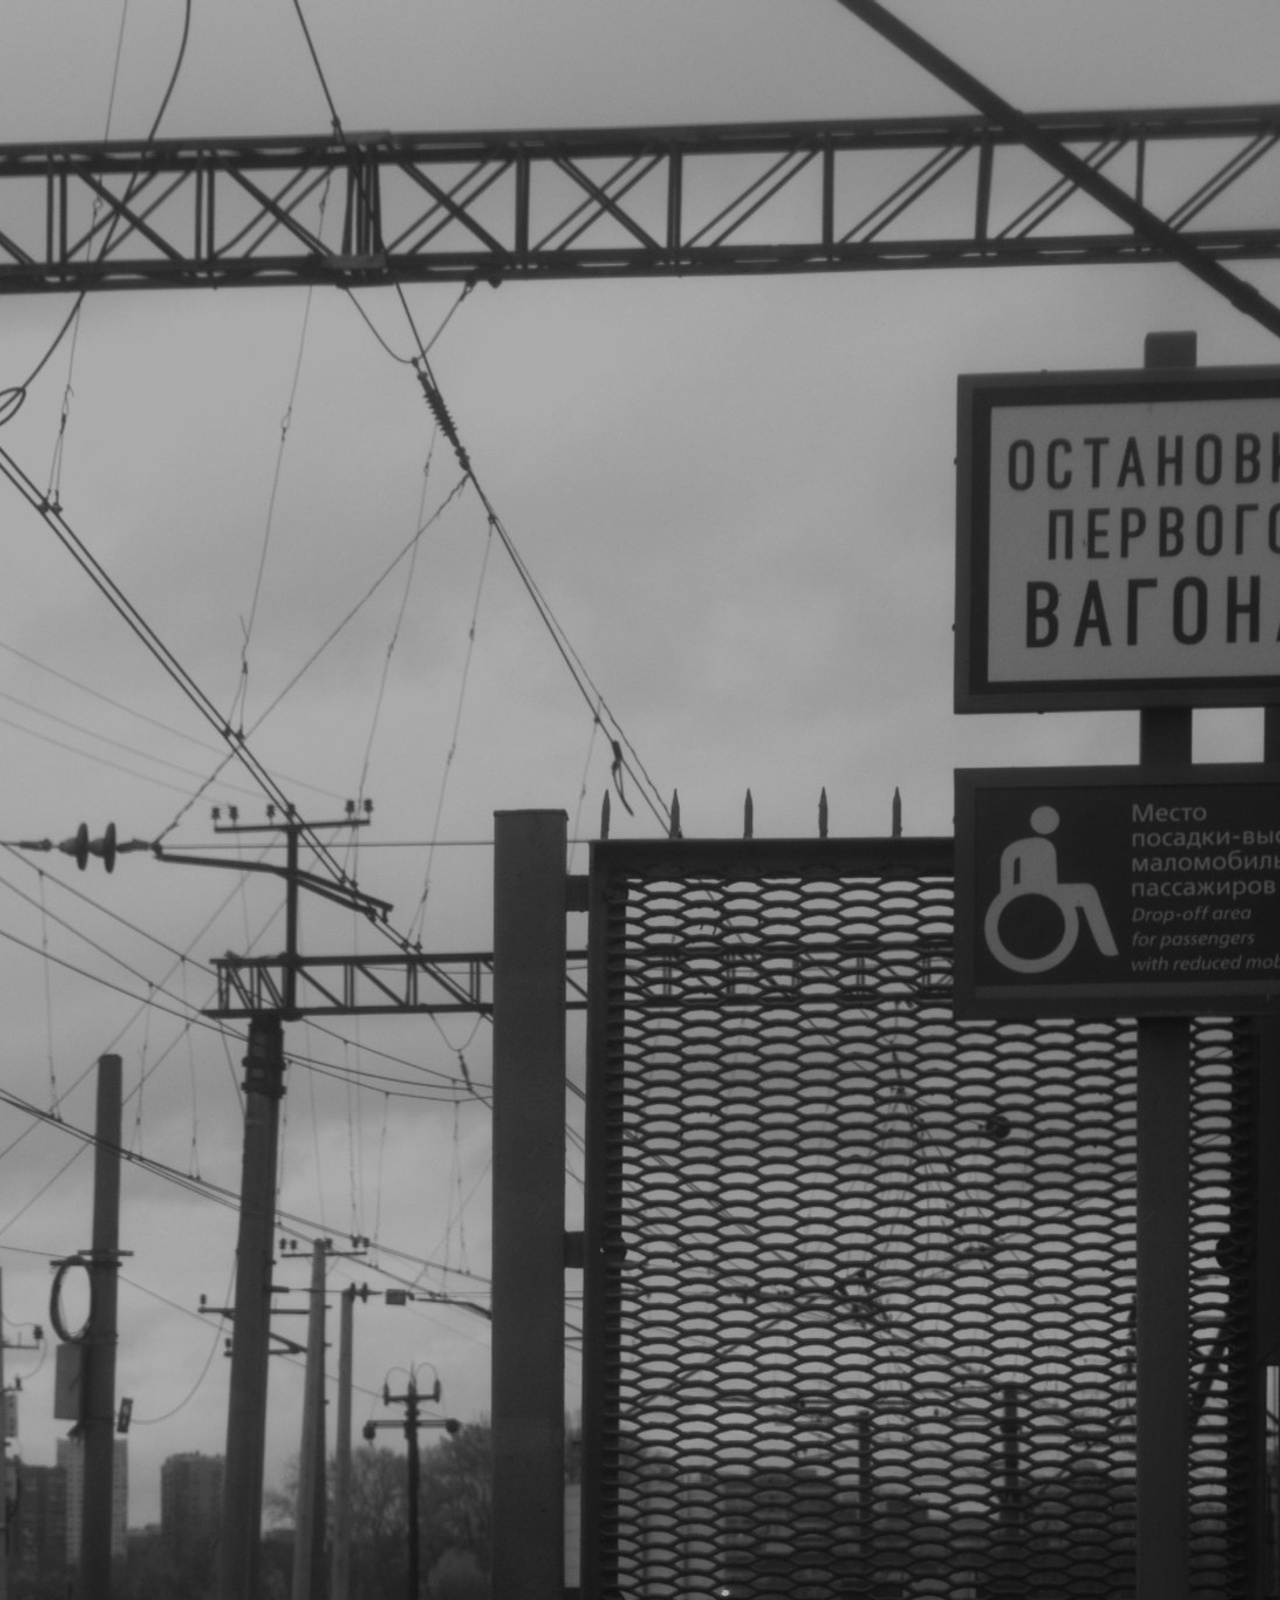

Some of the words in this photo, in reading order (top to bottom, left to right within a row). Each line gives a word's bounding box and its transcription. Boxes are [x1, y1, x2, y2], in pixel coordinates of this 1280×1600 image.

[1026, 575, 1280, 648] ВАГОН
[1132, 804, 1207, 823] Место
[1132, 879, 1276, 900] пассажиров
[1132, 905, 1211, 924] Drop-off
[1212, 907, 1252, 920] area
[1132, 932, 1157, 948] for
[1159, 932, 1255, 950] passengers
[1131, 955, 1169, 972] with
[1173, 953, 1243, 971] reduced
